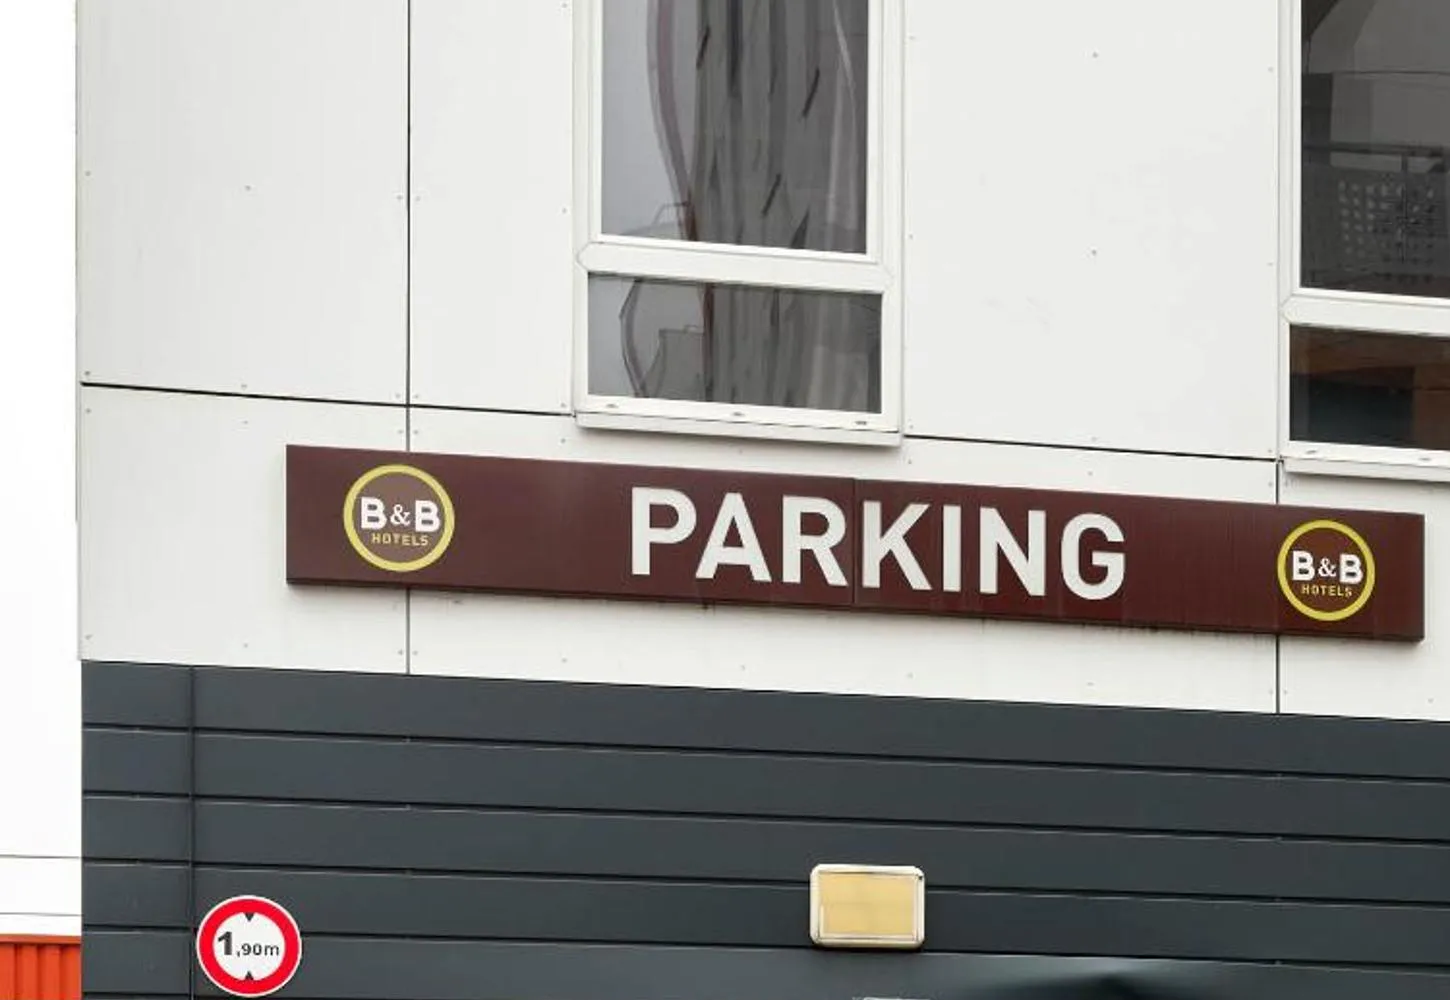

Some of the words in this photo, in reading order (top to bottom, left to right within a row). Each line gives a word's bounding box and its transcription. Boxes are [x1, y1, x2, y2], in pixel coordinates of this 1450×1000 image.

[360, 496, 442, 534] B&B
[371, 532, 430, 548] HOTELS
[631, 486, 1127, 601] PARKING
[1291, 549, 1364, 586] B&B
[1301, 583, 1353, 599] HOTELS
